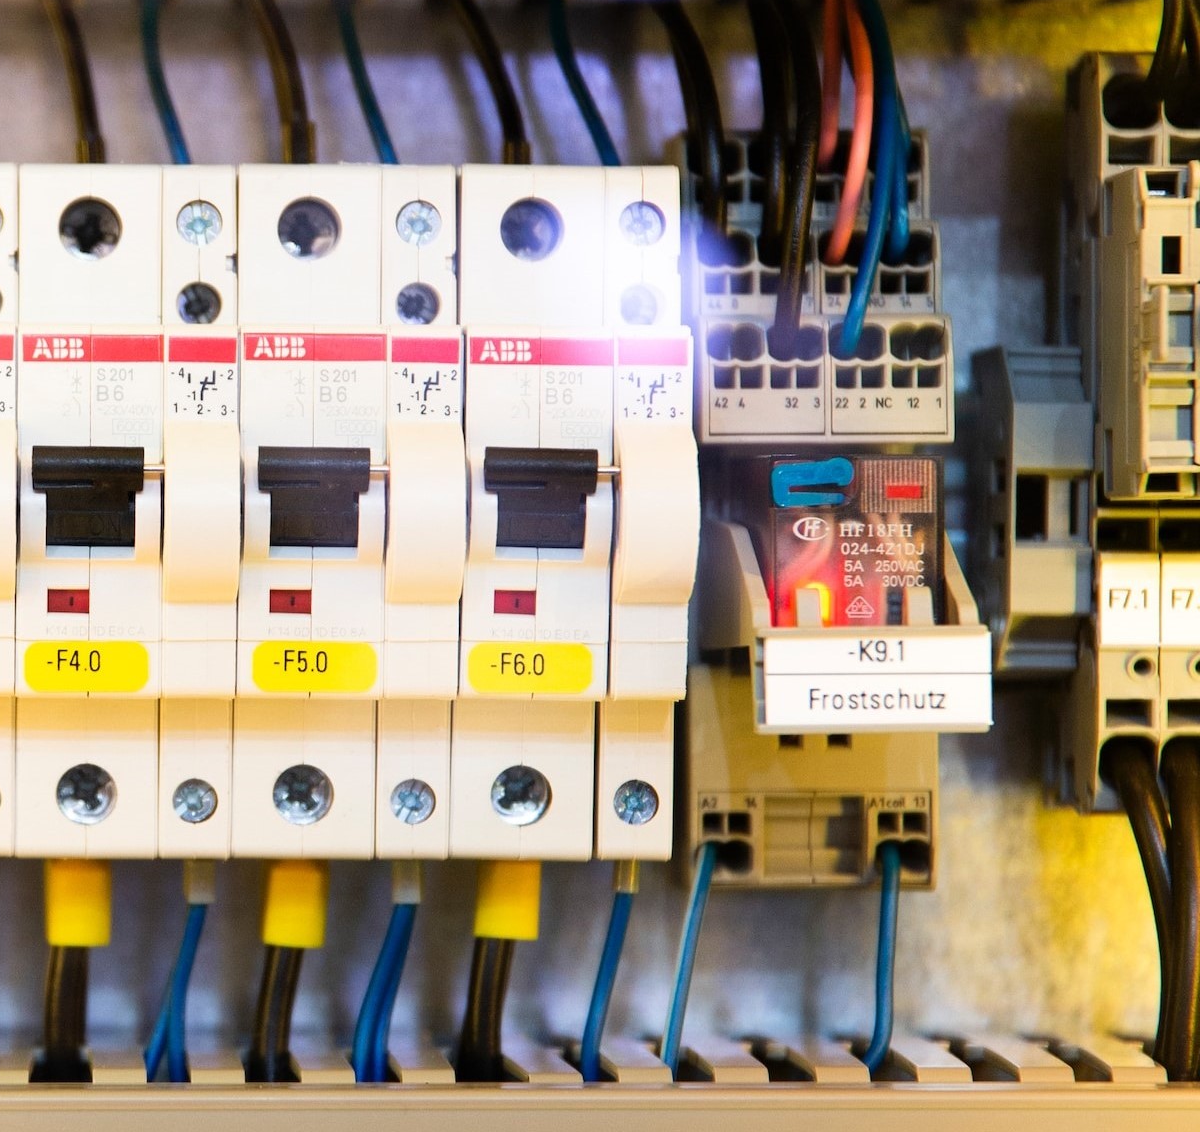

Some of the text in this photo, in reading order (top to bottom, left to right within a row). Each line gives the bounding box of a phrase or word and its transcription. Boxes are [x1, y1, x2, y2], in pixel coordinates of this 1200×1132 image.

[32, 338, 85, 359] ABB
[253, 336, 307, 359] ABB
[479, 340, 533, 362] ABB
[111, 368, 135, 381] 201
[96, 385, 124, 401] B 6
[714, 396, 821, 409] 42 4 32 3
[835, 396, 942, 409] 22 2 NC 12 1
[839, 523, 913, 538] HF18FH
[840, 542, 925, 556] 024-4Z1DJ
[843, 560, 924, 573] 5A 250VAC
[843, 575, 924, 587] 5A 30VDC
[1108, 588, 1148, 609] F7.1
[47, 649, 101, 672] -F4.0
[273, 649, 328, 673] -F5.0
[848, 639, 905, 663] -K9.1
[491, 652, 545, 676] -F6.0
[809, 688, 947, 710] Frostschutz
